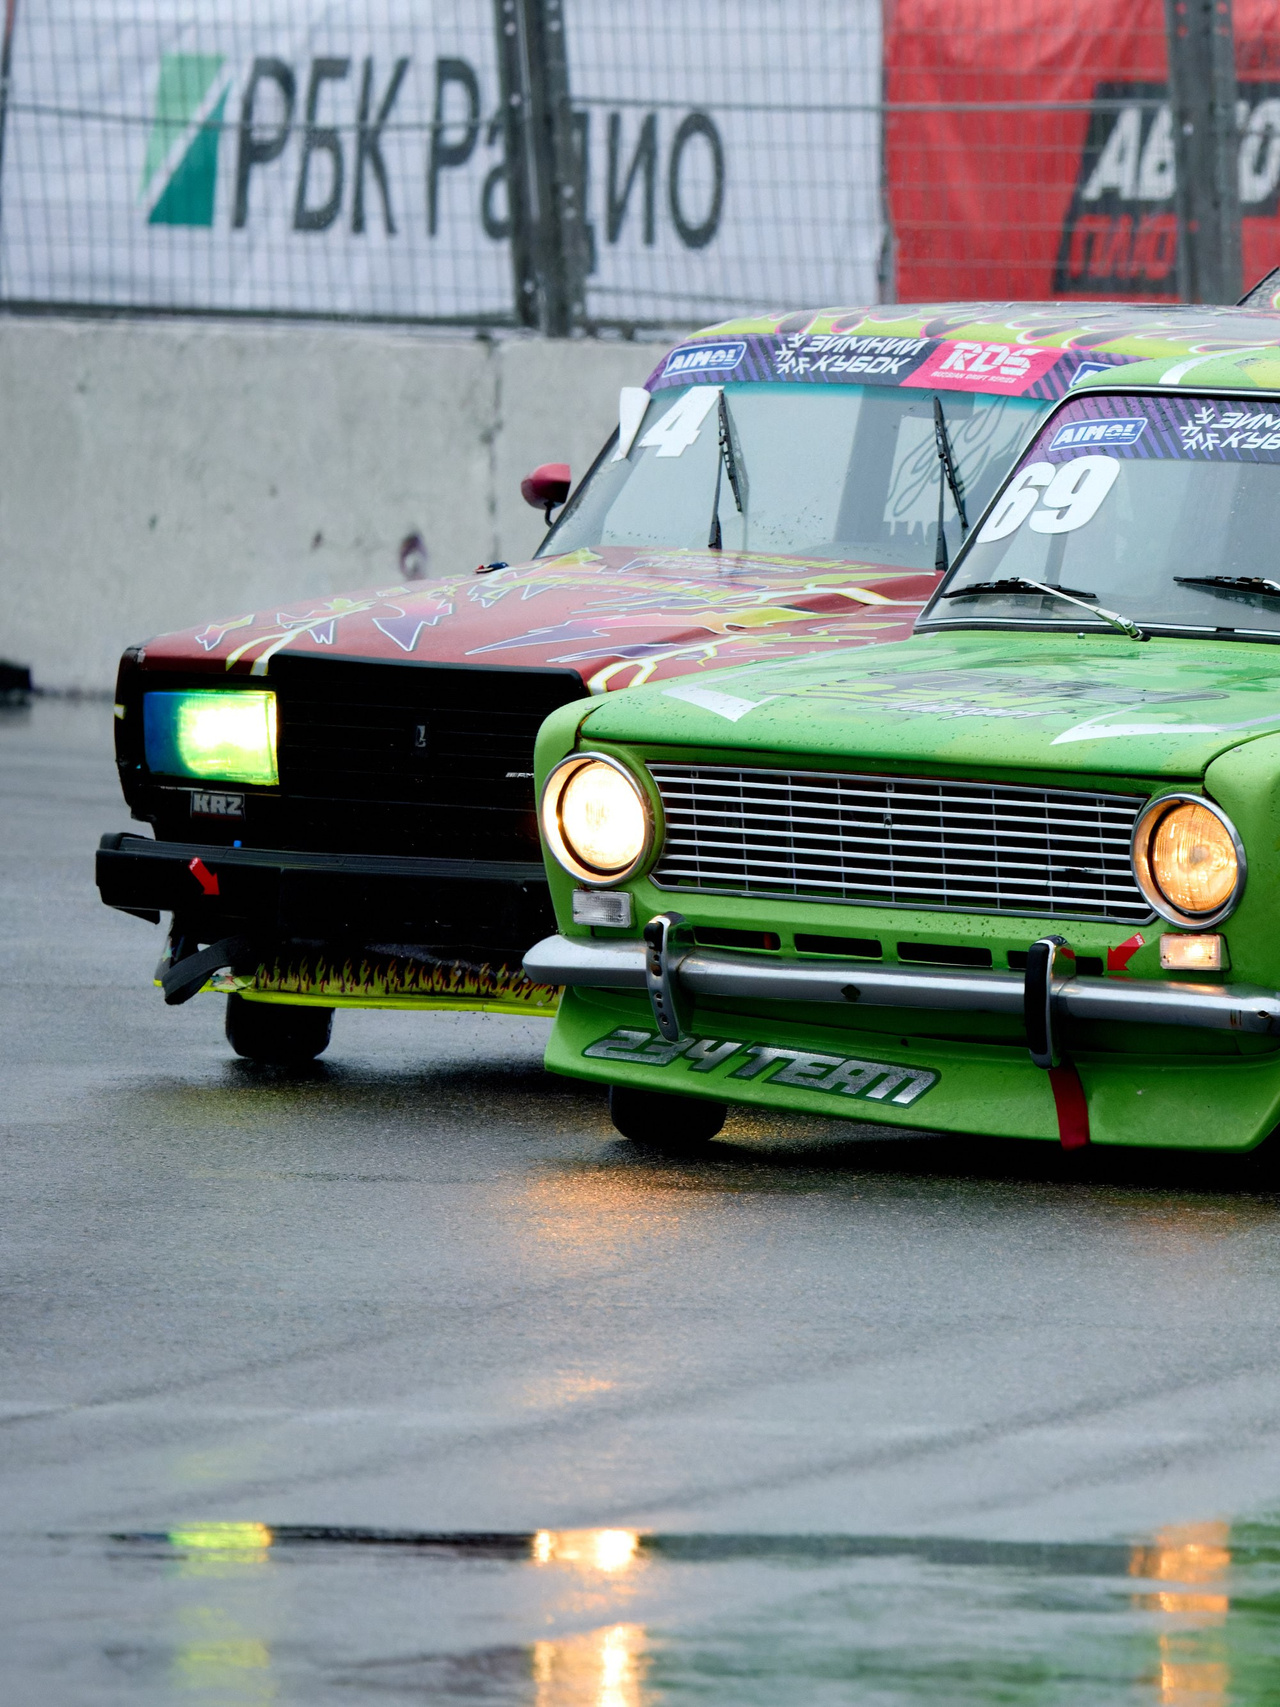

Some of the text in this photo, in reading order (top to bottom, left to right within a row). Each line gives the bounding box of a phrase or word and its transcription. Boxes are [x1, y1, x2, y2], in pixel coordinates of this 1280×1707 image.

[231, 56, 412, 234] РБК
[801, 335, 931, 356] ЗИМНИЙ
[667, 348, 736, 371] AIMOL
[809, 355, 912, 375] КУБОК
[939, 341, 1047, 376] RDS
[1055, 424, 1138, 445] AIMOL
[976, 454, 1121, 544] 69
[193, 792, 242, 816] KRZ
[733, 1045, 939, 1104] TEAM
